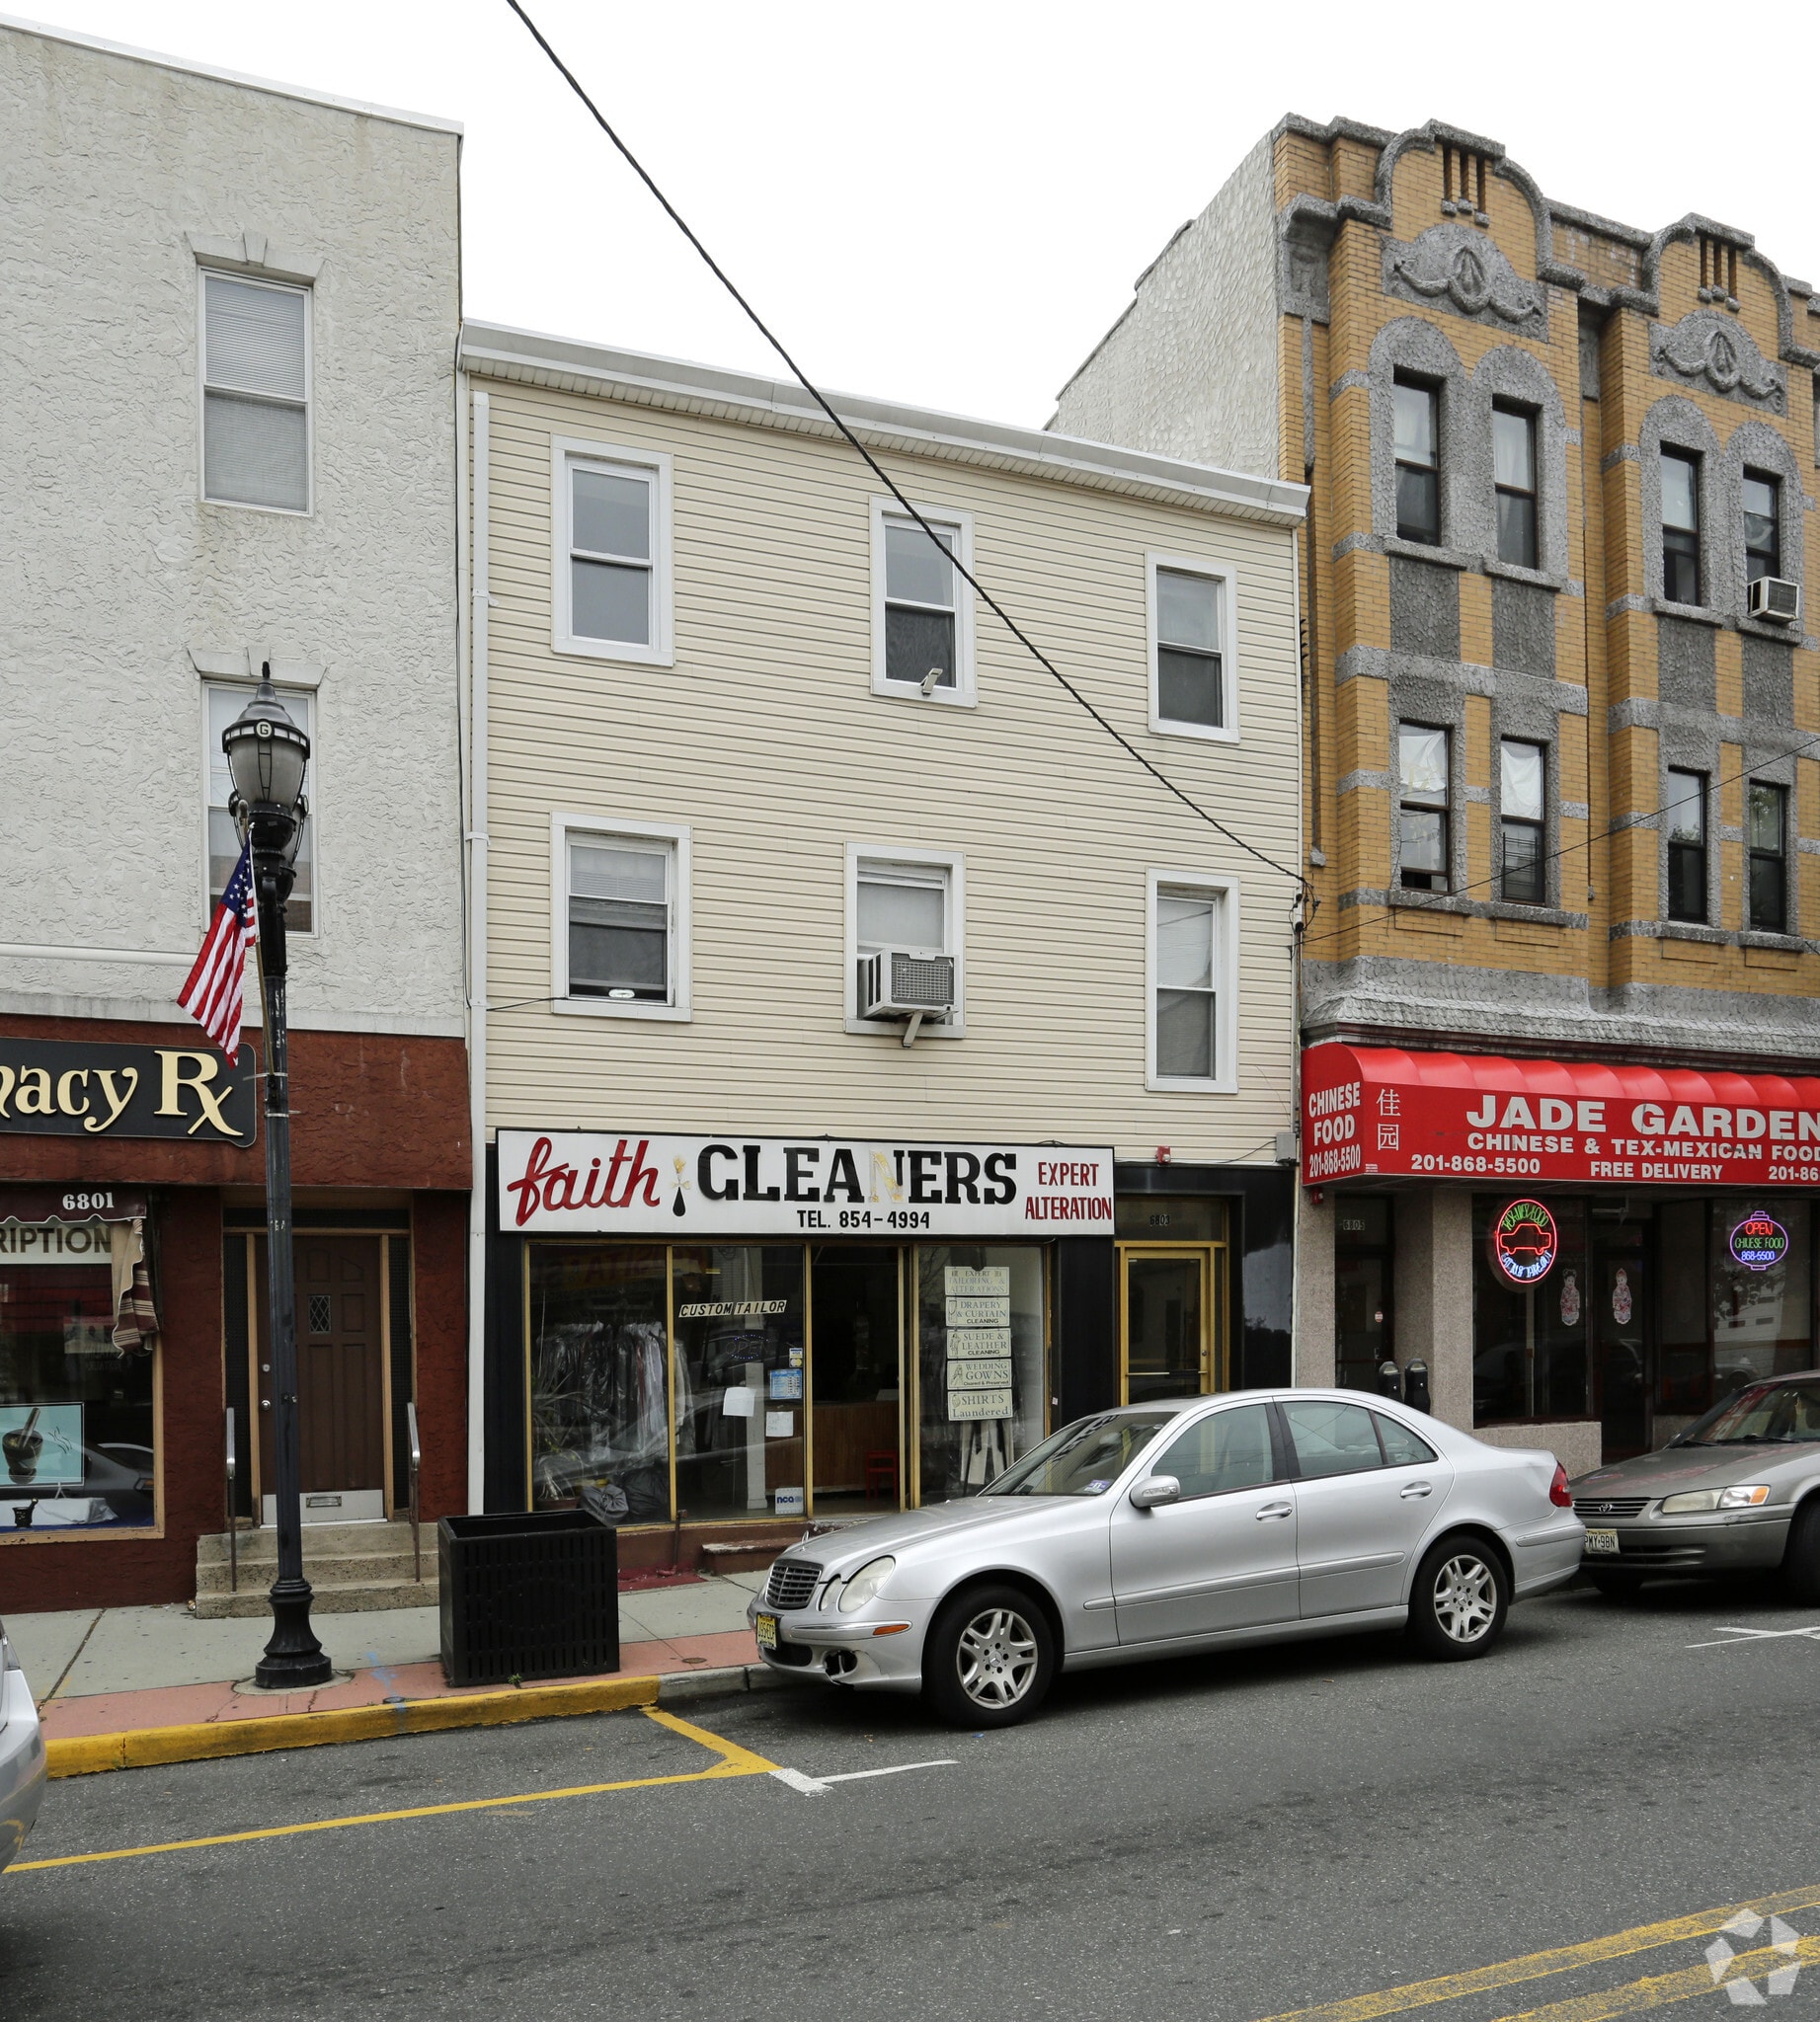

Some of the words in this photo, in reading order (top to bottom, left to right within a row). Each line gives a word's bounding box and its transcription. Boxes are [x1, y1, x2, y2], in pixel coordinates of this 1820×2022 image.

[1308, 1081, 1361, 1118] CHINESE
[1465, 1094, 1607, 1132] JADE
[1631, 1103, 1820, 1141] GARDEN
[1313, 1114, 1356, 1146] FOOD
[1467, 1132, 1574, 1153] CHINESE
[1584, 1137, 1601, 1154] &
[1611, 1138, 1762, 1160] TEX-MEXICAN
[1308, 1144, 1361, 1178] 201-868-5500
[1411, 1153, 1541, 1174] 201-868-5500
[1038, 1161, 1099, 1187] EXPERT
[1590, 1161, 1634, 1178] FREE
[1641, 1162, 1723, 1180] DELIVERY
[507, 1136, 661, 1226] faith
[697, 1144, 1017, 1205] CLEANERS
[62, 1192, 115, 1211] 6801
[1024, 1196, 1112, 1220] ALTERATION
[797, 1209, 831, 1229] TEL.
[838, 1209, 930, 1229] 854-4994
[1149, 1213, 1170, 1226] 6803
[1745, 1221, 1774, 1235] OPEN
[1765, 1237, 1784, 1249] FOOD
[1741, 1250, 1776, 1261] 868-5500
[680, 1302, 733, 1317] CUSTOM
[736, 1300, 786, 1314] TAILOR
[960, 1300, 1002, 1309] DRAPERY
[965, 1309, 1007, 1318] CURTAIN
[963, 1332, 994, 1341] SUEDE
[962, 1341, 1007, 1351] LEATHER
[965, 1362, 1007, 1371] WEDDING
[965, 1370, 1008, 1380] GOWNS
[961, 1394, 1004, 1406] SHIRTS
[952, 1406, 1008, 1418] Laundered
